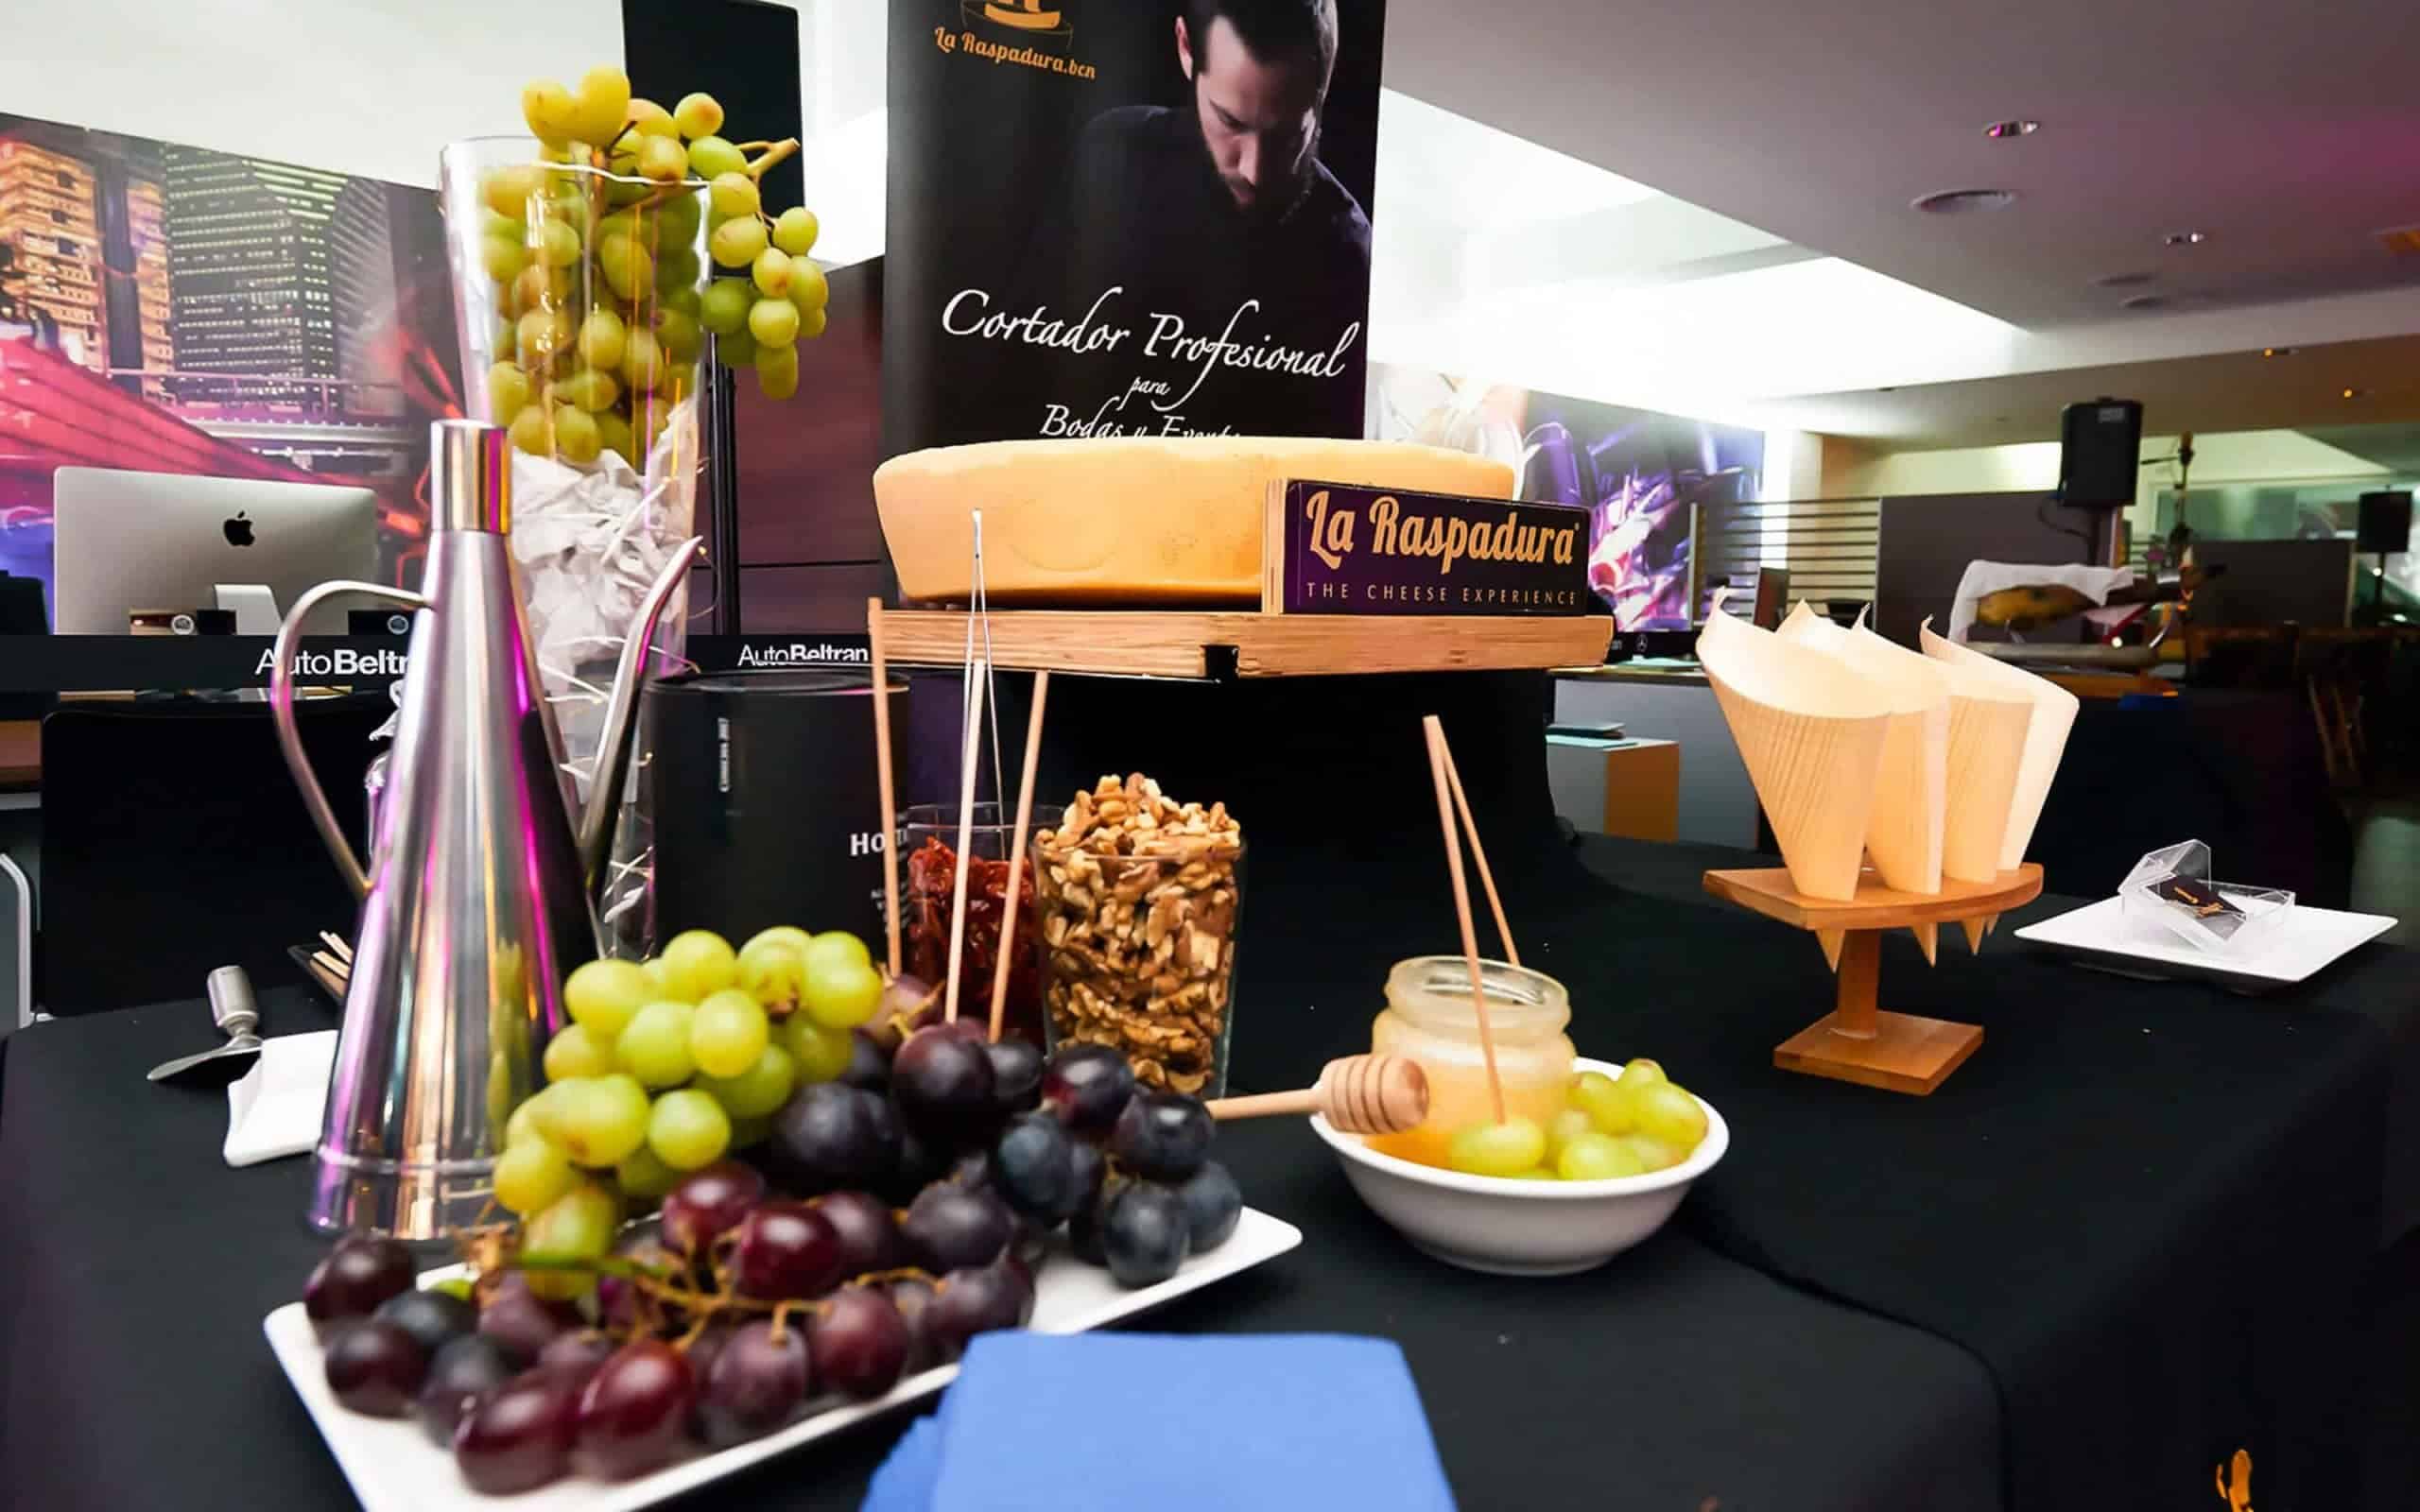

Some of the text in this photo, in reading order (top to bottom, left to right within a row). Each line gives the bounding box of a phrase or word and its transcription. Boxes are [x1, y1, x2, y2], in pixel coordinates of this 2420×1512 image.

[934, 26, 1097, 80] La Raspadura.bcn
[942, 286, 1360, 411] Cortador Profesional
[1115, 375, 1172, 411] para
[1039, 395, 1124, 438] Bodas
[1305, 490, 1575, 575] La Raspadura
[1305, 581, 1577, 606] THE CHEESE EXPERIENCE
[737, 643, 869, 667] AutoBeltran
